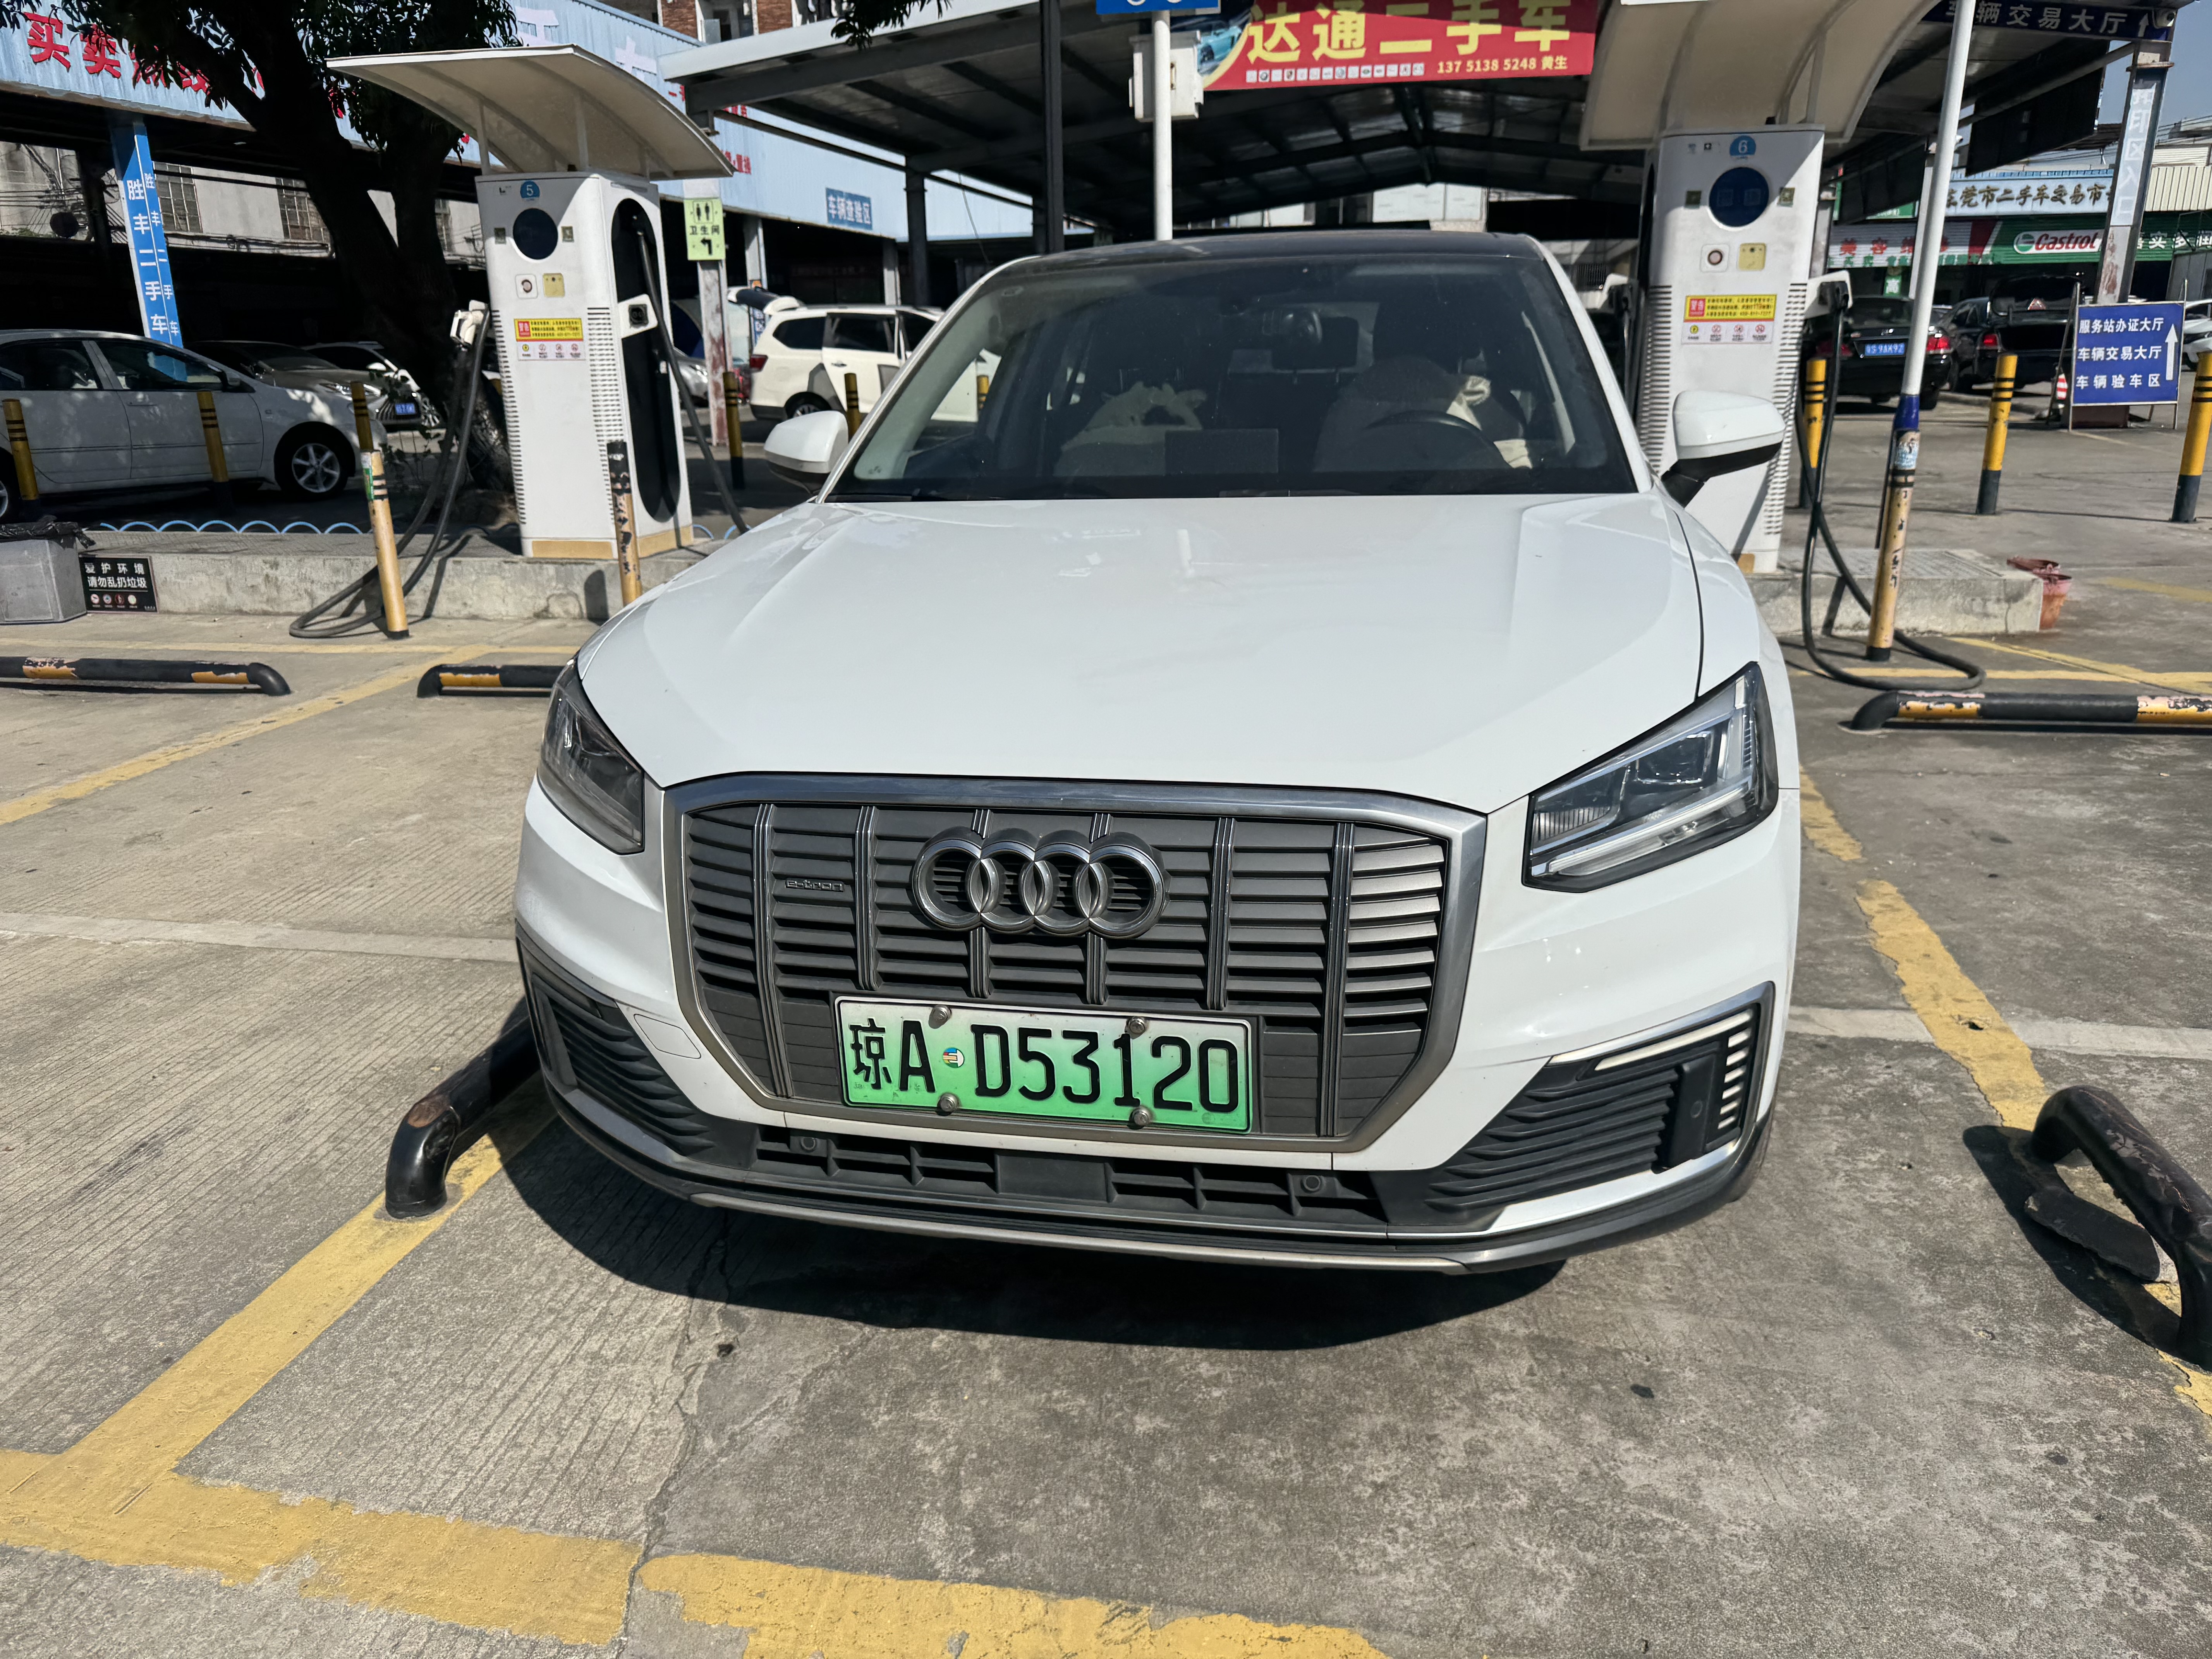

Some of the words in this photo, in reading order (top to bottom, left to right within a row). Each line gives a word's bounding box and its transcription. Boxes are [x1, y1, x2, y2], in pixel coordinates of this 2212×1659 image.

[1247, 0, 1571, 64] 达通二手车
[1437, 61, 1462, 74] 137
[1466, 60, 1499, 72] 5138
[1503, 58, 1536, 71] 5248
[1538, 55, 1568, 70] 黄生
[1738, 140, 1748, 154] 6
[526, 184, 534, 196] 5
[1946, 184, 2113, 209] 东莞市二手车交易市
[689, 225, 720, 235] 卫生间
[2035, 232, 2098, 251] Castrol
[127, 179, 168, 334] 胜丰二手车
[144, 173, 179, 336] 胜丰二手车
[2079, 317, 2164, 333] 服务站办证大厅
[2077, 345, 2162, 361] 车辆交易大厅
[2076, 374, 2160, 390] 车辆验车区
[84, 562, 144, 575] 爱护环境
[88, 576, 147, 589] 请勿乱扔垃圾
[787, 879, 843, 892] e-tron
[849, 1018, 936, 1093] 琼A
[970, 1024, 1239, 1112] D53120
